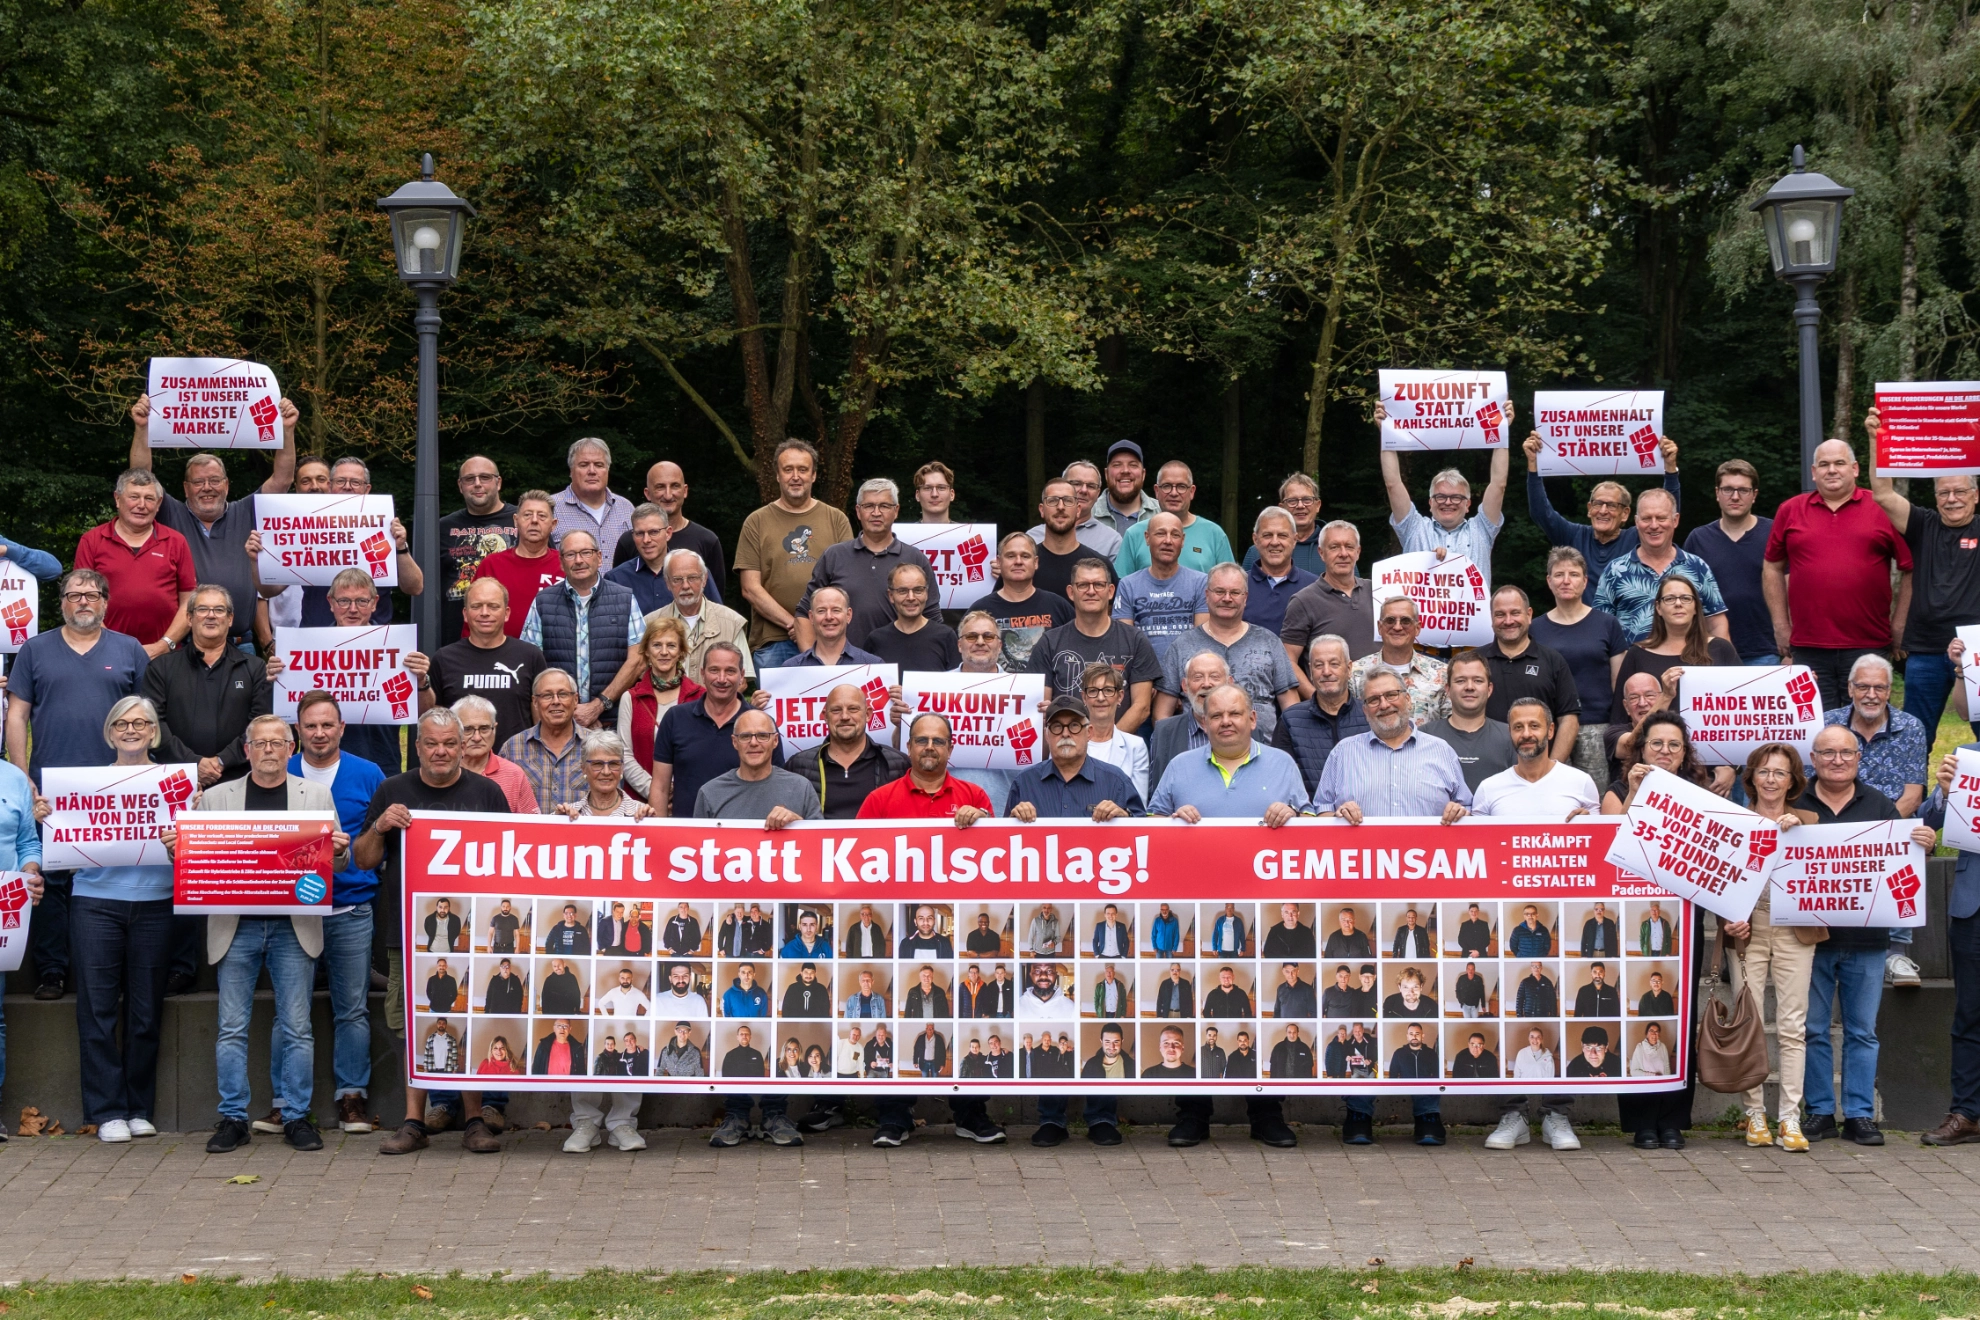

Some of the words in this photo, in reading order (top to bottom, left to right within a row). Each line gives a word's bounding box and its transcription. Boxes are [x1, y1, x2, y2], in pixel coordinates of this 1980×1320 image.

[161, 377, 267, 388] ZUSAMMENHALT
[178, 391, 198, 402] IST
[202, 390, 249, 402] UNSERE
[1394, 383, 1490, 401] ZUKUNFT
[162, 404, 237, 419] STÄRKSTE
[1415, 402, 1464, 416] STATT
[1540, 409, 1654, 423] ZUSAMMENHALT
[173, 422, 230, 434] MARKE.
[1394, 417, 1474, 429] KAHLSCHLAG!
[1550, 426, 1570, 437] IST
[1574, 425, 1624, 436] UNSERE
[1558, 438, 1627, 457] STÄRKE!
[263, 515, 386, 530] ZUSAMMENHALT
[274, 533, 295, 545] IST
[300, 532, 355, 545] UNSERE
[282, 547, 358, 566] STÄRKE!
[1382, 569, 1430, 586] HÄNDE
[1433, 574, 1464, 587] WEG
[1402, 585, 1425, 597] VON
[1428, 588, 1450, 598] DER
[289, 648, 400, 671] ZUKUNFT
[313, 672, 370, 688] STATT
[463, 674, 511, 689] PUMA
[288, 690, 380, 702] KACHLAG!
[918, 692, 1026, 715] ZUKUNFT
[1692, 693, 1747, 711] HÄNDE
[1751, 696, 1787, 710] WEG
[775, 697, 827, 727] JETZ
[1702, 714, 1730, 726] VON
[1734, 714, 1794, 726] UNSEREN
[1691, 727, 1806, 742] ARBEITSPLÄTZEN!
[56, 792, 116, 811] HÄNDE
[121, 793, 159, 809] WEG
[88, 812, 121, 825] VON
[126, 811, 156, 824] DER
[1646, 791, 1706, 829] HÄNDE
[1702, 819, 1744, 848] WEG
[53, 825, 176, 842] ALTERSTEILZE
[1512, 833, 1592, 849] ERKÄMPFT
[1661, 816, 1691, 839] VON
[1691, 832, 1720, 853] DER
[1633, 820, 1748, 885] 35-STUNDEN-
[1785, 842, 1911, 860] ZUSAMMENHALT
[427, 829, 652, 882] Zukunft
[668, 838, 802, 883] statt
[821, 834, 1149, 895] Kahlschlag!
[1252, 848, 1488, 880] GEMEINSAM
[1512, 855, 1588, 868] ERHALTEN
[1805, 862, 1827, 874] IST
[1831, 860, 1885, 874] UNSERE
[1512, 874, 1596, 887] GESTALTEN
[1657, 851, 1728, 896] WOCHE!
[1611, 884, 1673, 895] Paderbor
[1786, 877, 1872, 894] STÄRKSTE
[1798, 897, 1864, 911] MARKE.
